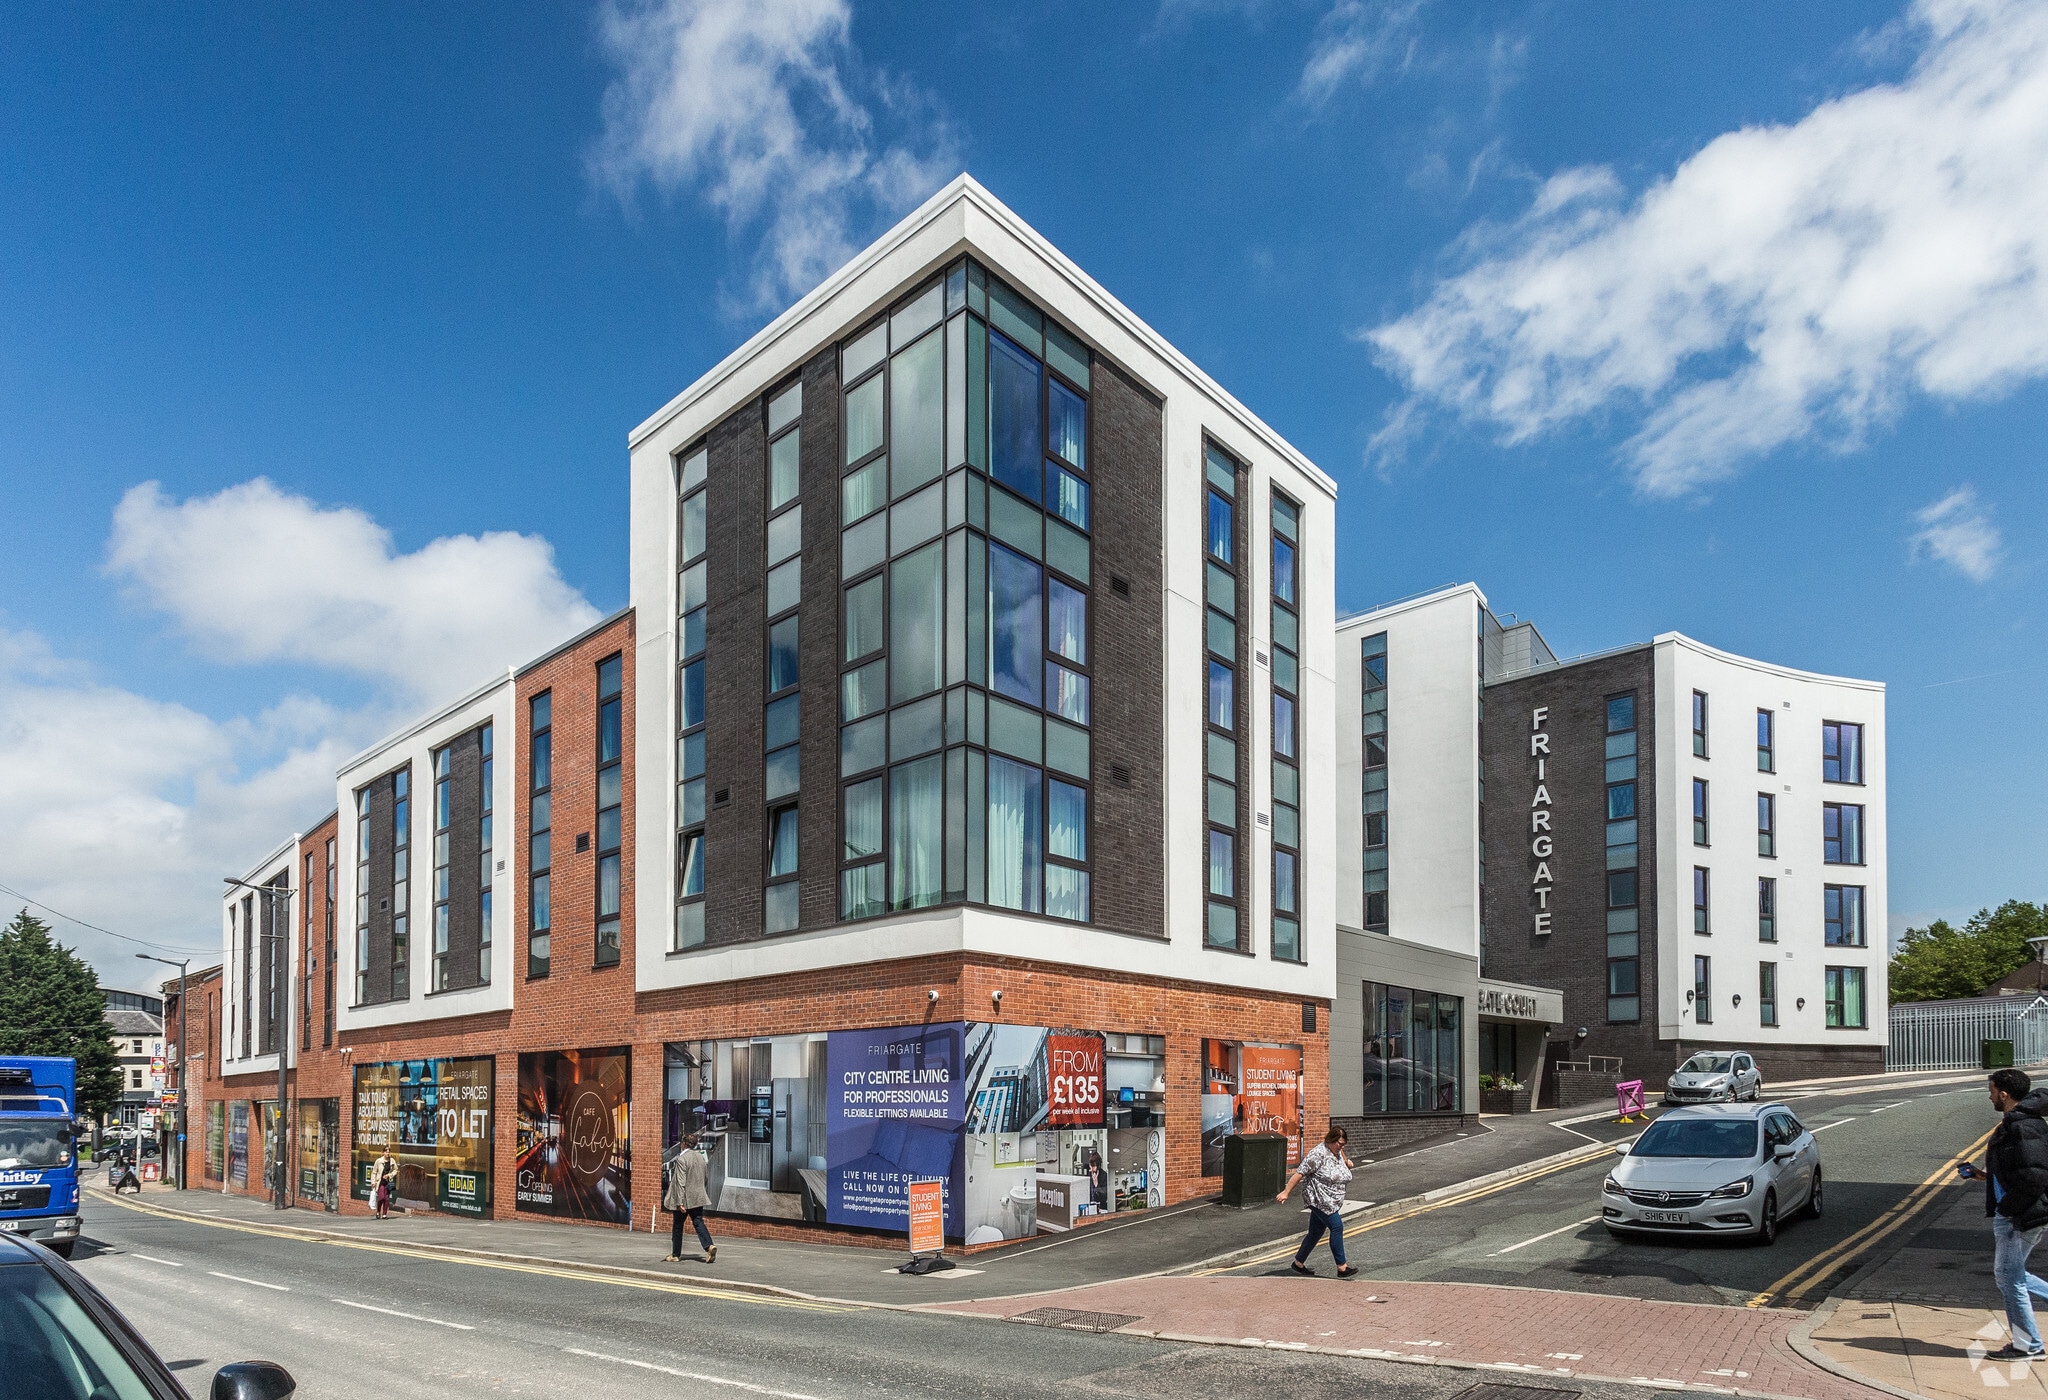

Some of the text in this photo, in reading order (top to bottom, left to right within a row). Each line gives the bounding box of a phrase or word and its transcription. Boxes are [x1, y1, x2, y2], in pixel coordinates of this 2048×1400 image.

[1531, 706, 1553, 935] FRIARGATE
[868, 1043, 922, 1056] FRIARGATE
[1053, 1050, 1099, 1072] FROM
[451, 1070, 478, 1079] FRIARGATE
[844, 1069, 949, 1085] CITY CENTRE LIVING
[1247, 1069, 1296, 1081] STUDENT LIVING
[440, 1086, 488, 1100] RETAIL SPACES
[1053, 1075, 1100, 1104] £135
[359, 1092, 387, 1103] TALK TO US
[844, 1090, 949, 1104] FOR PROFESSIONALS
[358, 1106, 388, 1117] ABOUT HOW
[583, 1107, 595, 1116] CAFE
[844, 1109, 948, 1118] FLEXIBLE LETTINGS AVAILABLE
[1053, 1108, 1061, 1116] per
[1062, 1107, 1074, 1115] week
[1081, 1107, 1100, 1115] inclusive
[1247, 1102, 1267, 1115] VIEW
[358, 1120, 398, 1132] WE CAN ASSIST
[440, 1109, 488, 1139] TO LET
[1248, 1118, 1269, 1132] NOW
[358, 1133, 387, 1145] YOUR MOVE
[572, 1116, 614, 1168] faba
[843, 1171, 860, 1180] LIVE
[863, 1172, 878, 1181] THE
[881, 1173, 899, 1182] LIFE
[902, 1174, 913, 1183] OF
[450, 1178, 474, 1191] HDAK
[532, 1181, 553, 1193] OPENING
[843, 1182, 862, 1192] CALL
[866, 1184, 884, 1193] NOW
[888, 1185, 900, 1194] ON
[518, 1191, 553, 1204] EARLY SUMMER
[912, 1192, 939, 1202] STUDENT
[912, 1202, 932, 1211] LIVING
[1645, 1212, 1683, 1221] SH16 VEV
